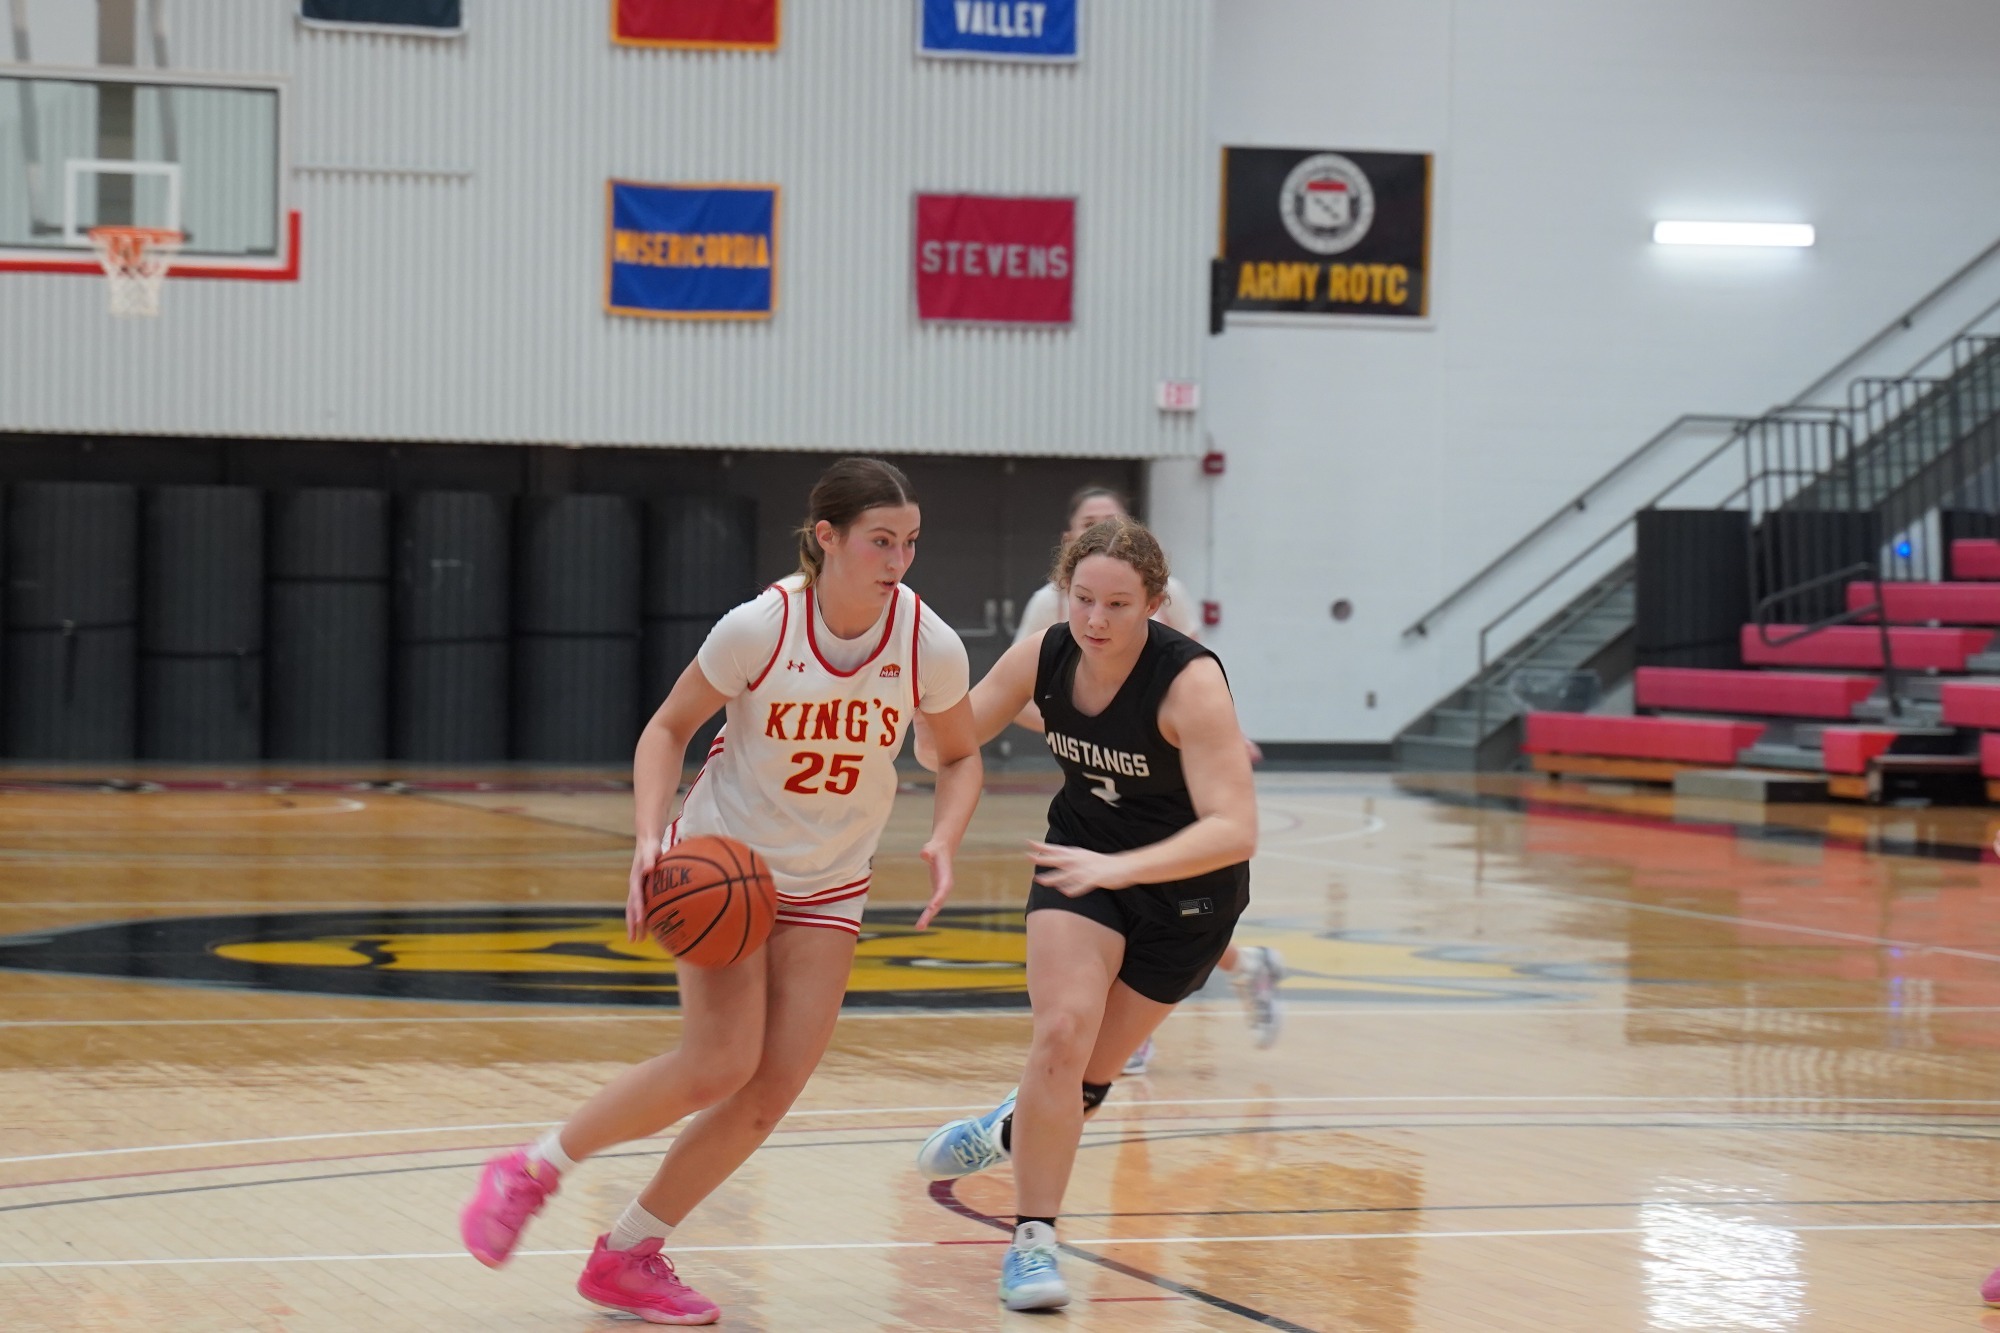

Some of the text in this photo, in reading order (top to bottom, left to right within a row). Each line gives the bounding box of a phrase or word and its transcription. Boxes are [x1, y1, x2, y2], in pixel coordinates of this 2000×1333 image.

[953, 0, 1046, 38] VALLEY
[615, 229, 769, 269] MISERICORDIA
[921, 240, 1069, 279] STEVENS
[1237, 261, 1408, 306] ARMY ROTC
[764, 698, 899, 747] KING'S
[783, 751, 865, 796] 25
[1045, 731, 1150, 777] MUSTANGS
